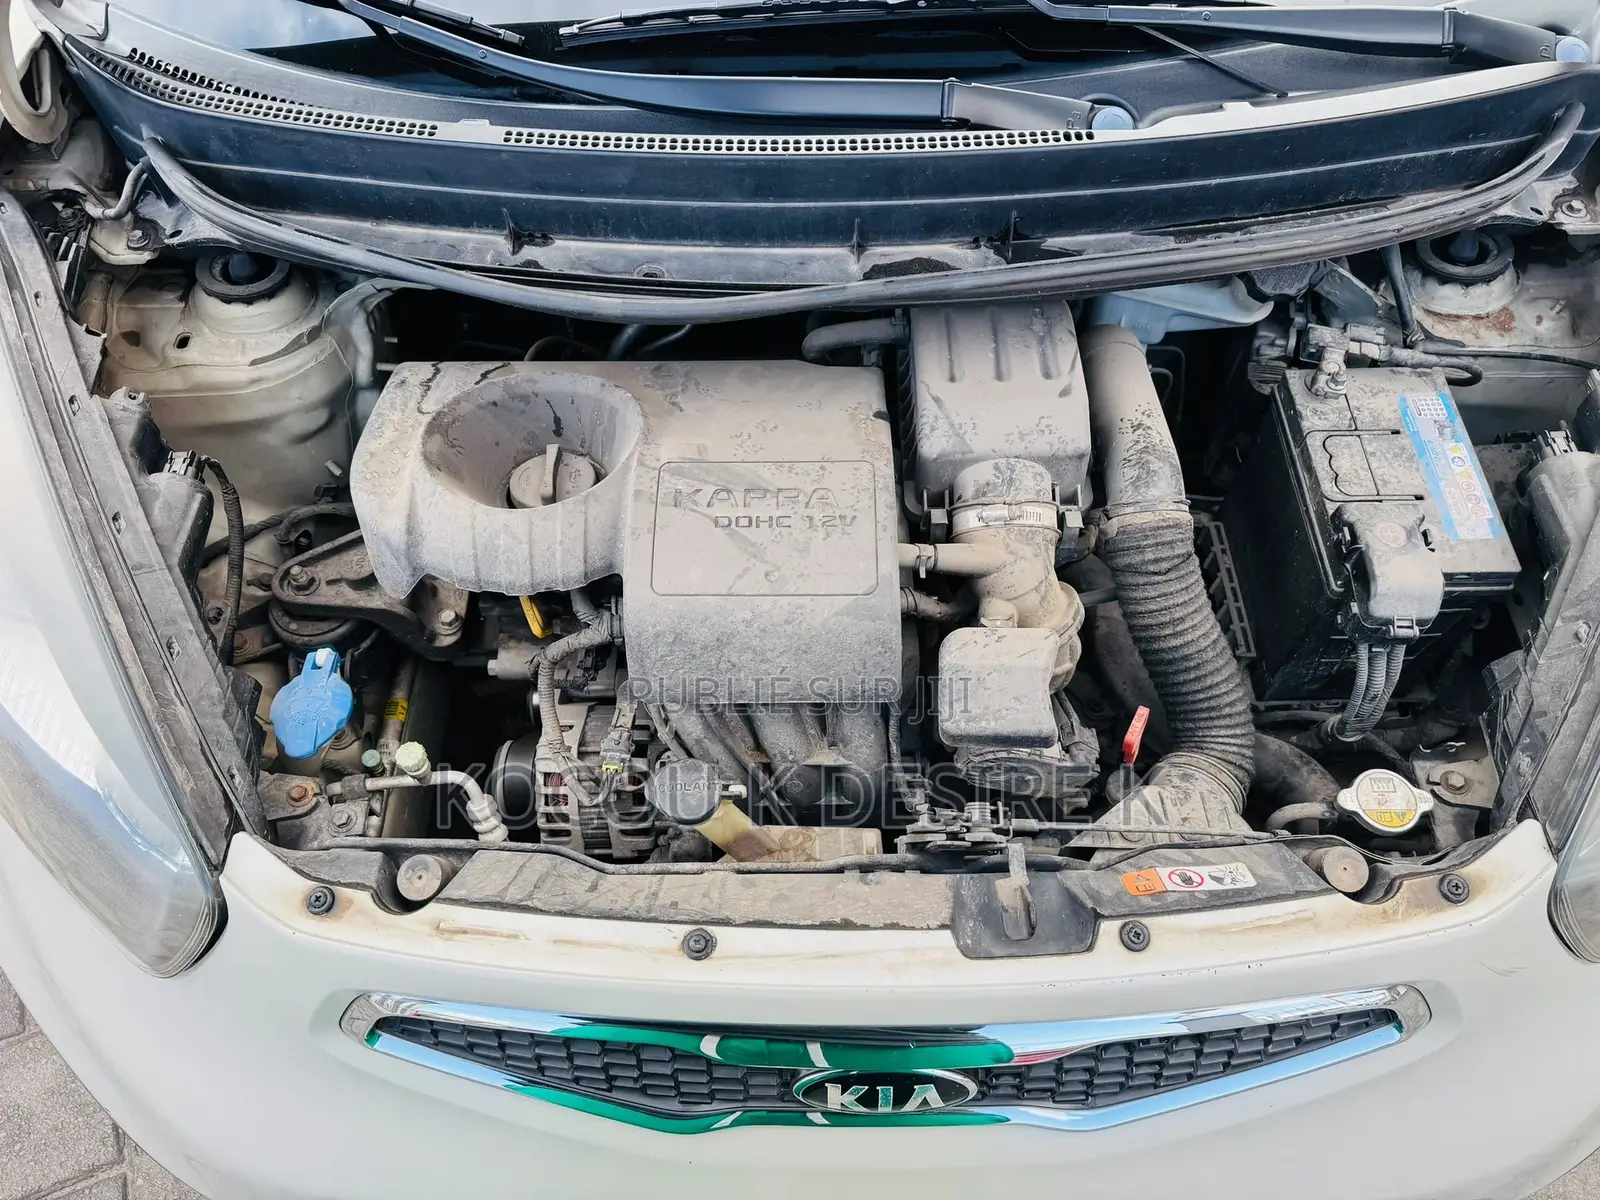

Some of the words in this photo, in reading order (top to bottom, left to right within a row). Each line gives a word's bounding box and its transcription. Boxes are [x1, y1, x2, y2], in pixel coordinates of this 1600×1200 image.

[673, 488, 840, 508] KAPPA
[714, 515, 792, 529] DOHC
[805, 515, 858, 529] 12V
[658, 779, 722, 793] COOLANT
[825, 1083, 946, 1112] KIA
